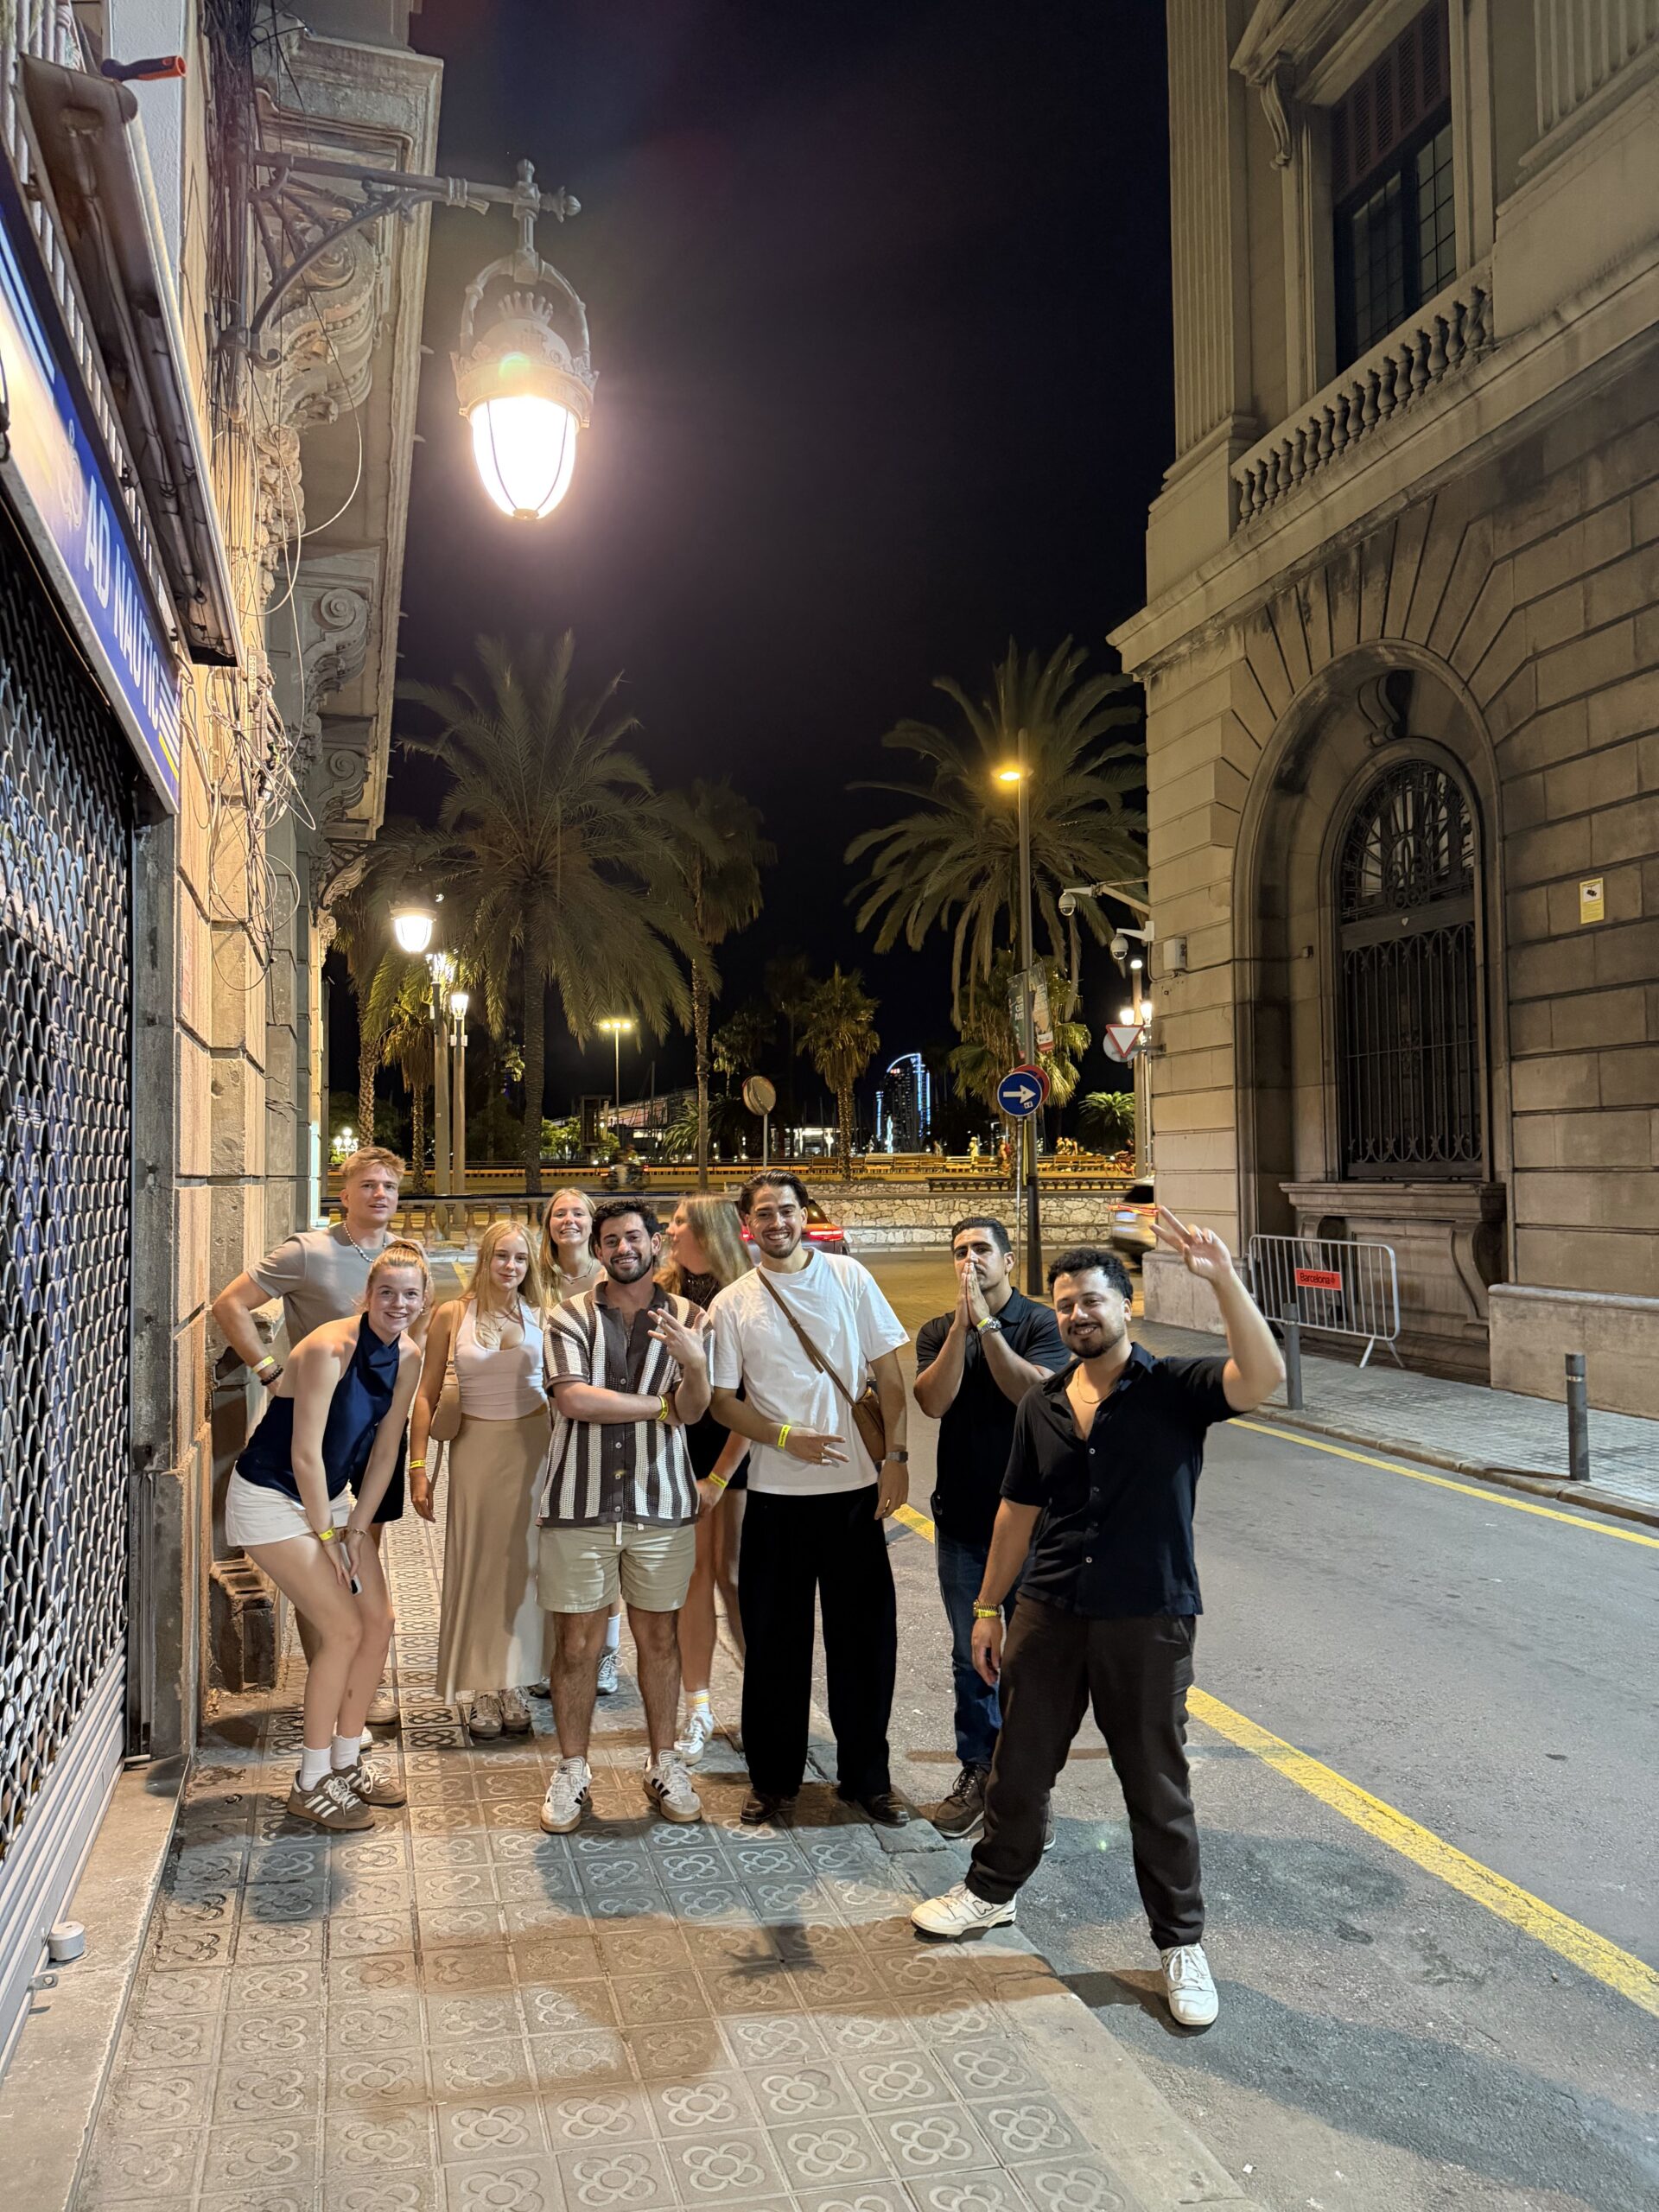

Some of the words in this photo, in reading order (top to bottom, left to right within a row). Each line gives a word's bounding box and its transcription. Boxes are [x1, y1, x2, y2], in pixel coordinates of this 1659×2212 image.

[84, 474, 111, 609] AD
[113, 543, 160, 731] NAUTIC
[1300, 1272, 1331, 1285] Barcelona
